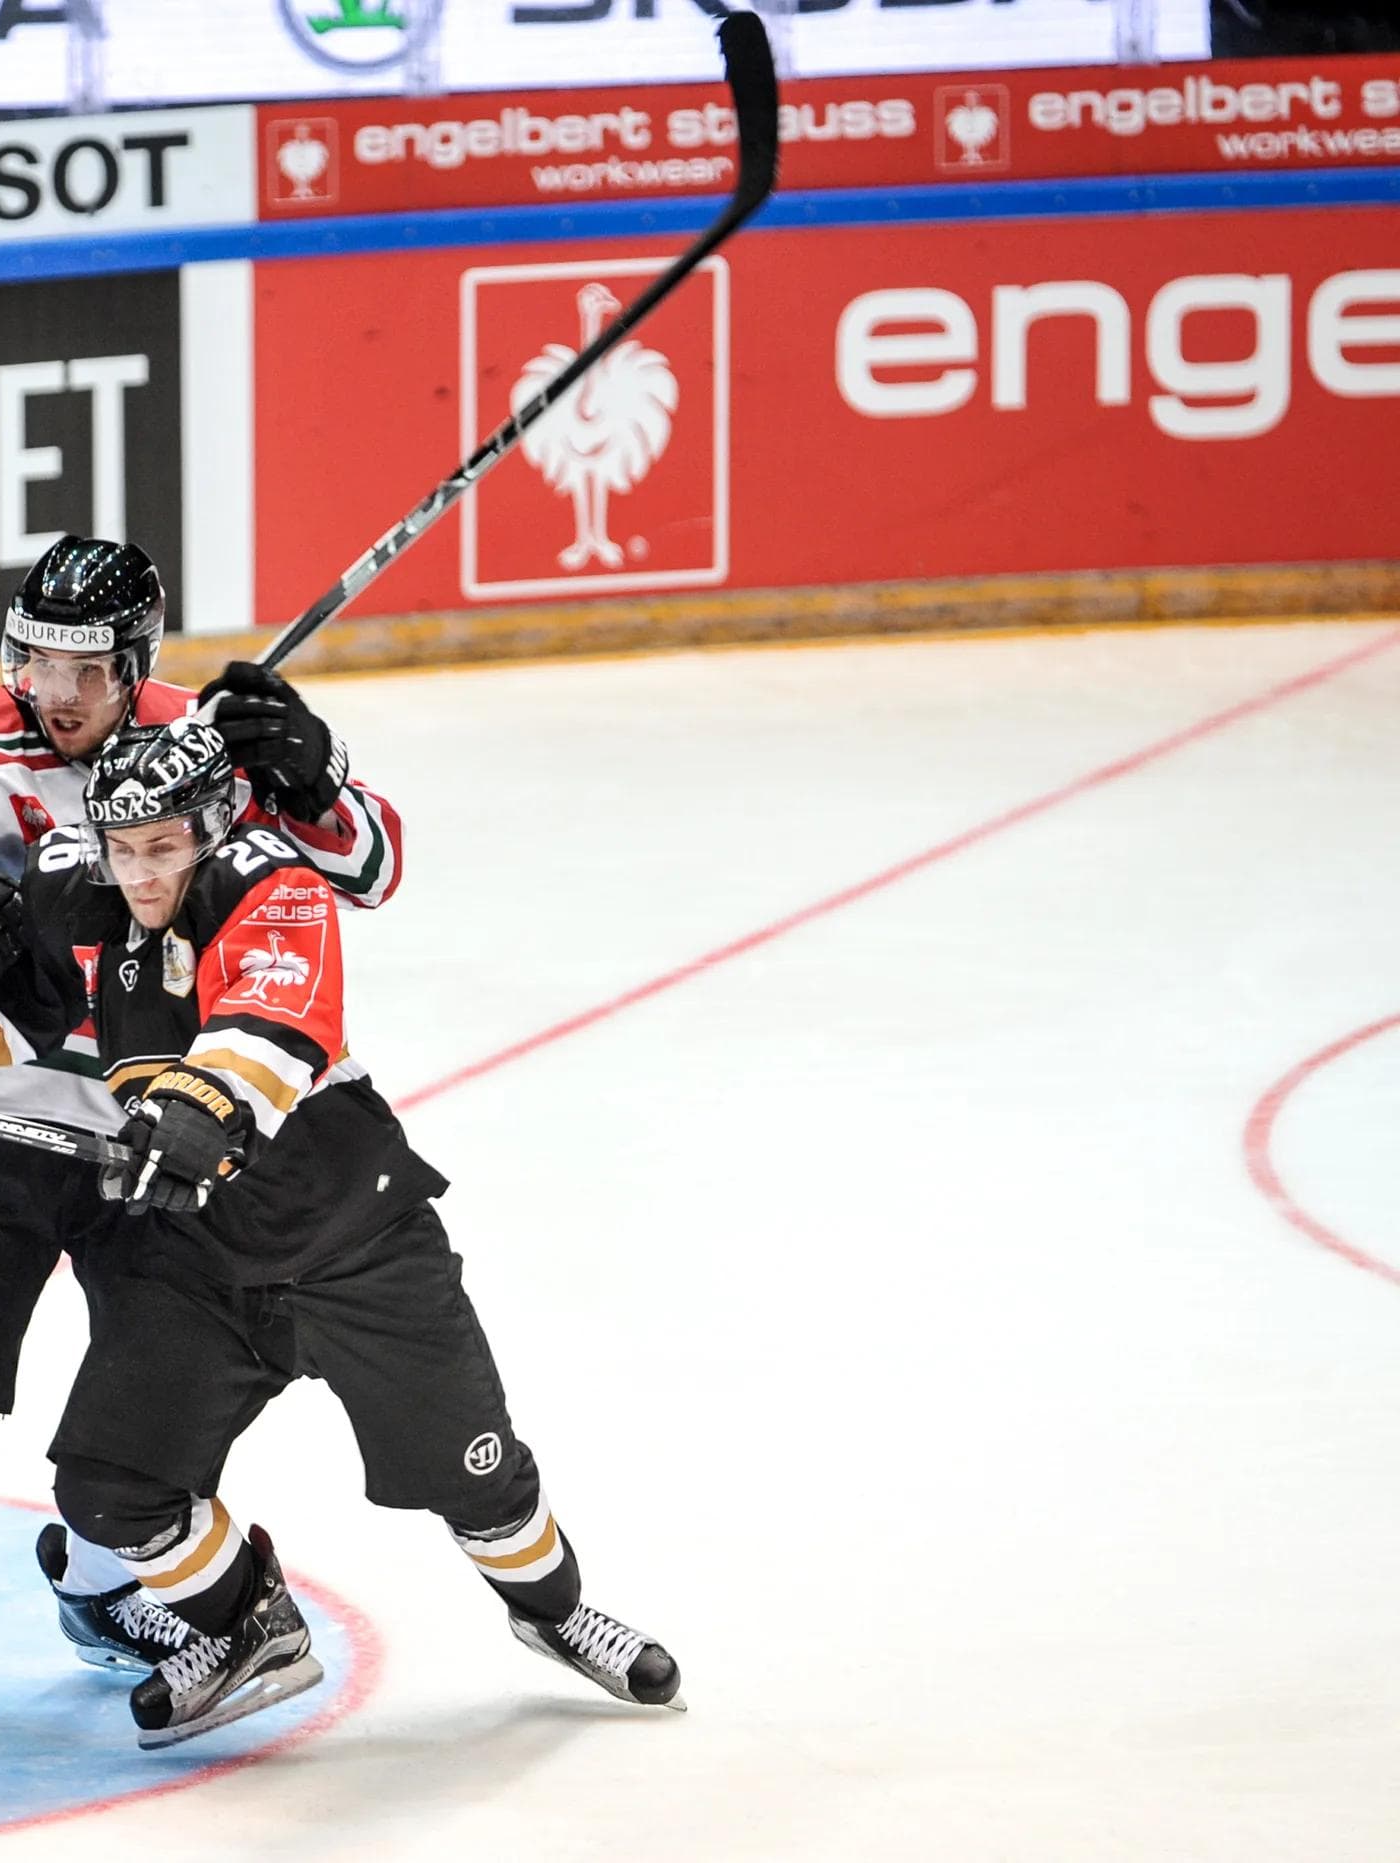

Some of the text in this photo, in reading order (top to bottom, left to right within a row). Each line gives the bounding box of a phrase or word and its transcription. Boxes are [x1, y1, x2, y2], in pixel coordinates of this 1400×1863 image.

[1028, 74, 1343, 136] engelbert
[353, 97, 917, 170] engelbert stauss
[531, 154, 735, 193] workwear
[835, 268, 1400, 441] enge
[16, 619, 111, 645] BJURFORS
[88, 789, 163, 822] DISAS
[215, 829, 299, 877] 26
[145, 1071, 235, 1122] RRIOR
